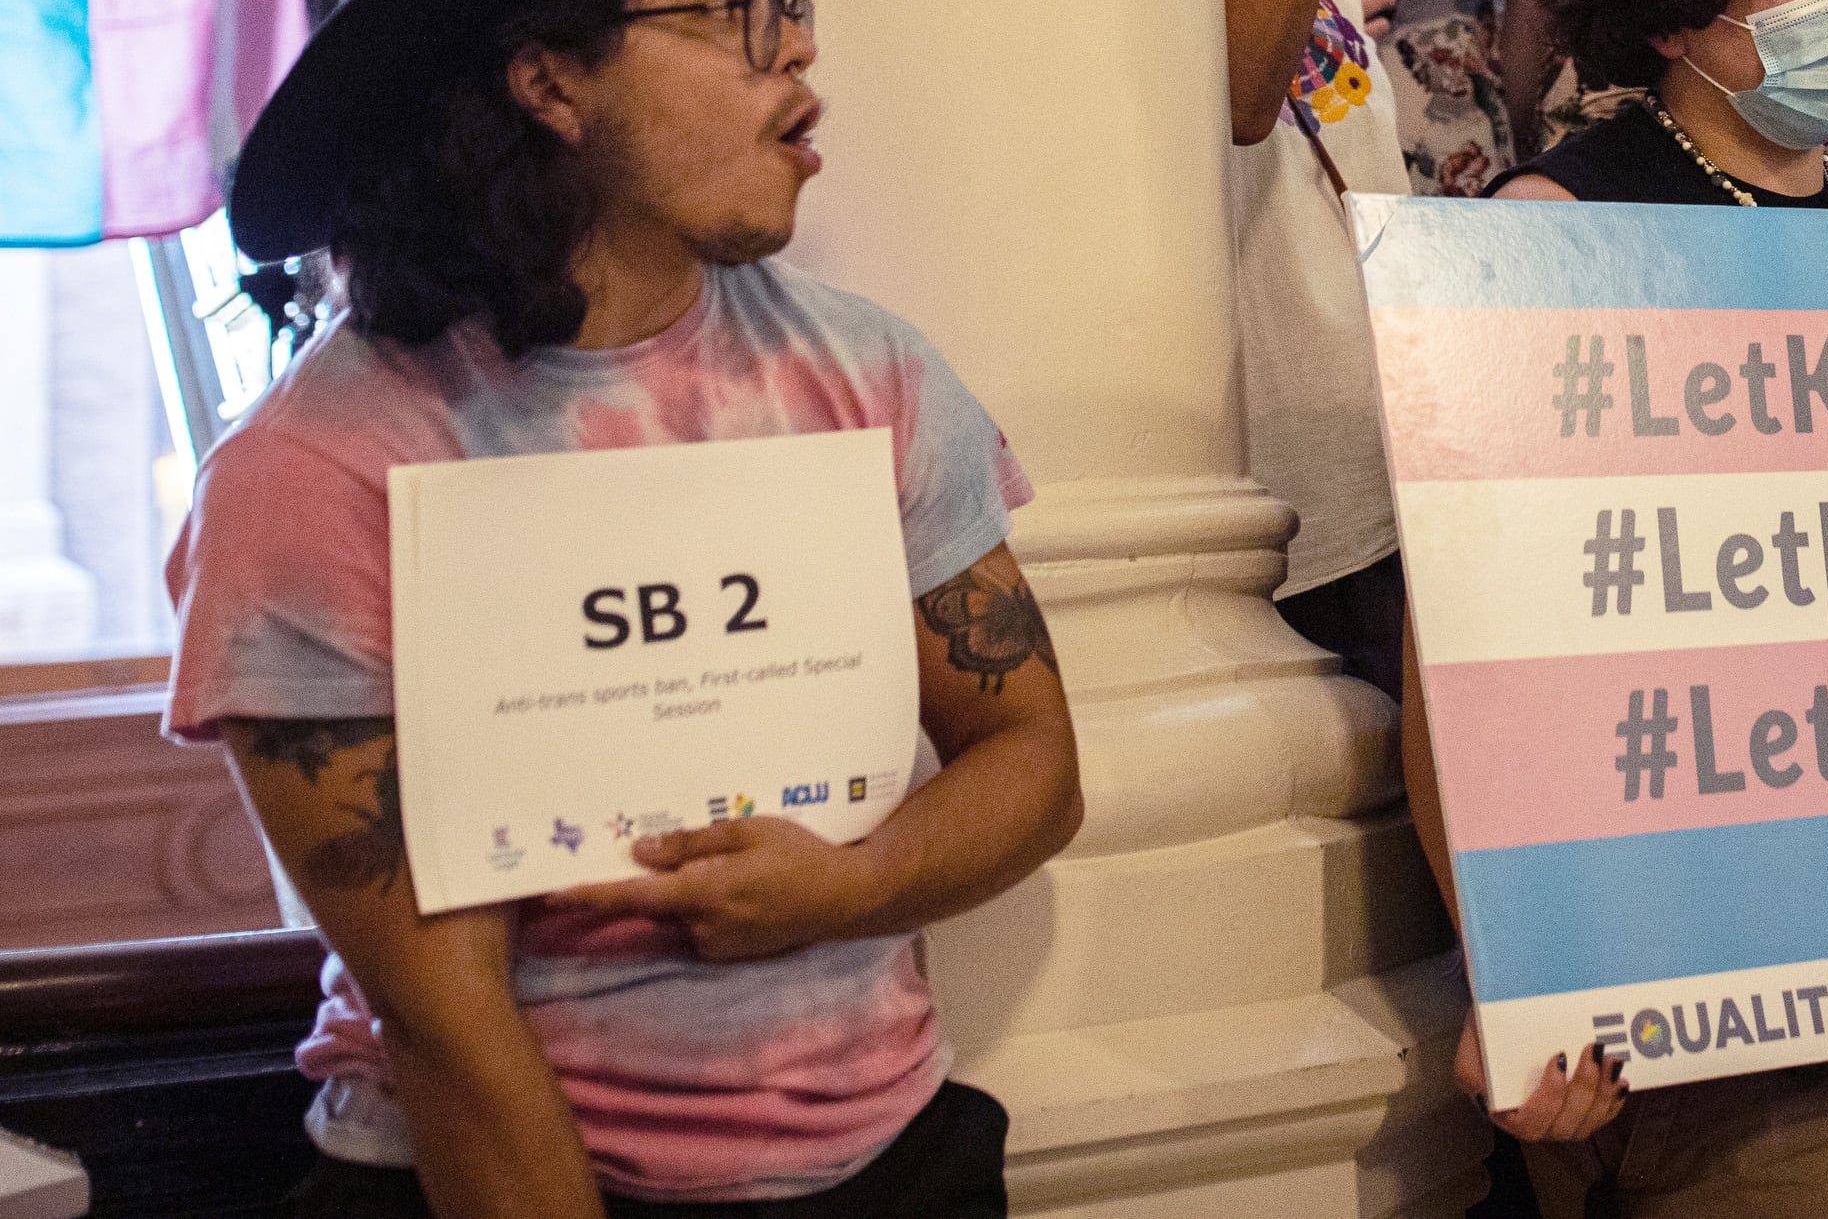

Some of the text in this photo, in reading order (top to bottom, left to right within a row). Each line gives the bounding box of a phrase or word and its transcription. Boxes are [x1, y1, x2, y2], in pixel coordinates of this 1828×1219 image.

[581, 573, 768, 651] SB 2
[803, 651, 863, 677] Special
[653, 698, 721, 721] Session
[782, 782, 829, 808] ACLU
